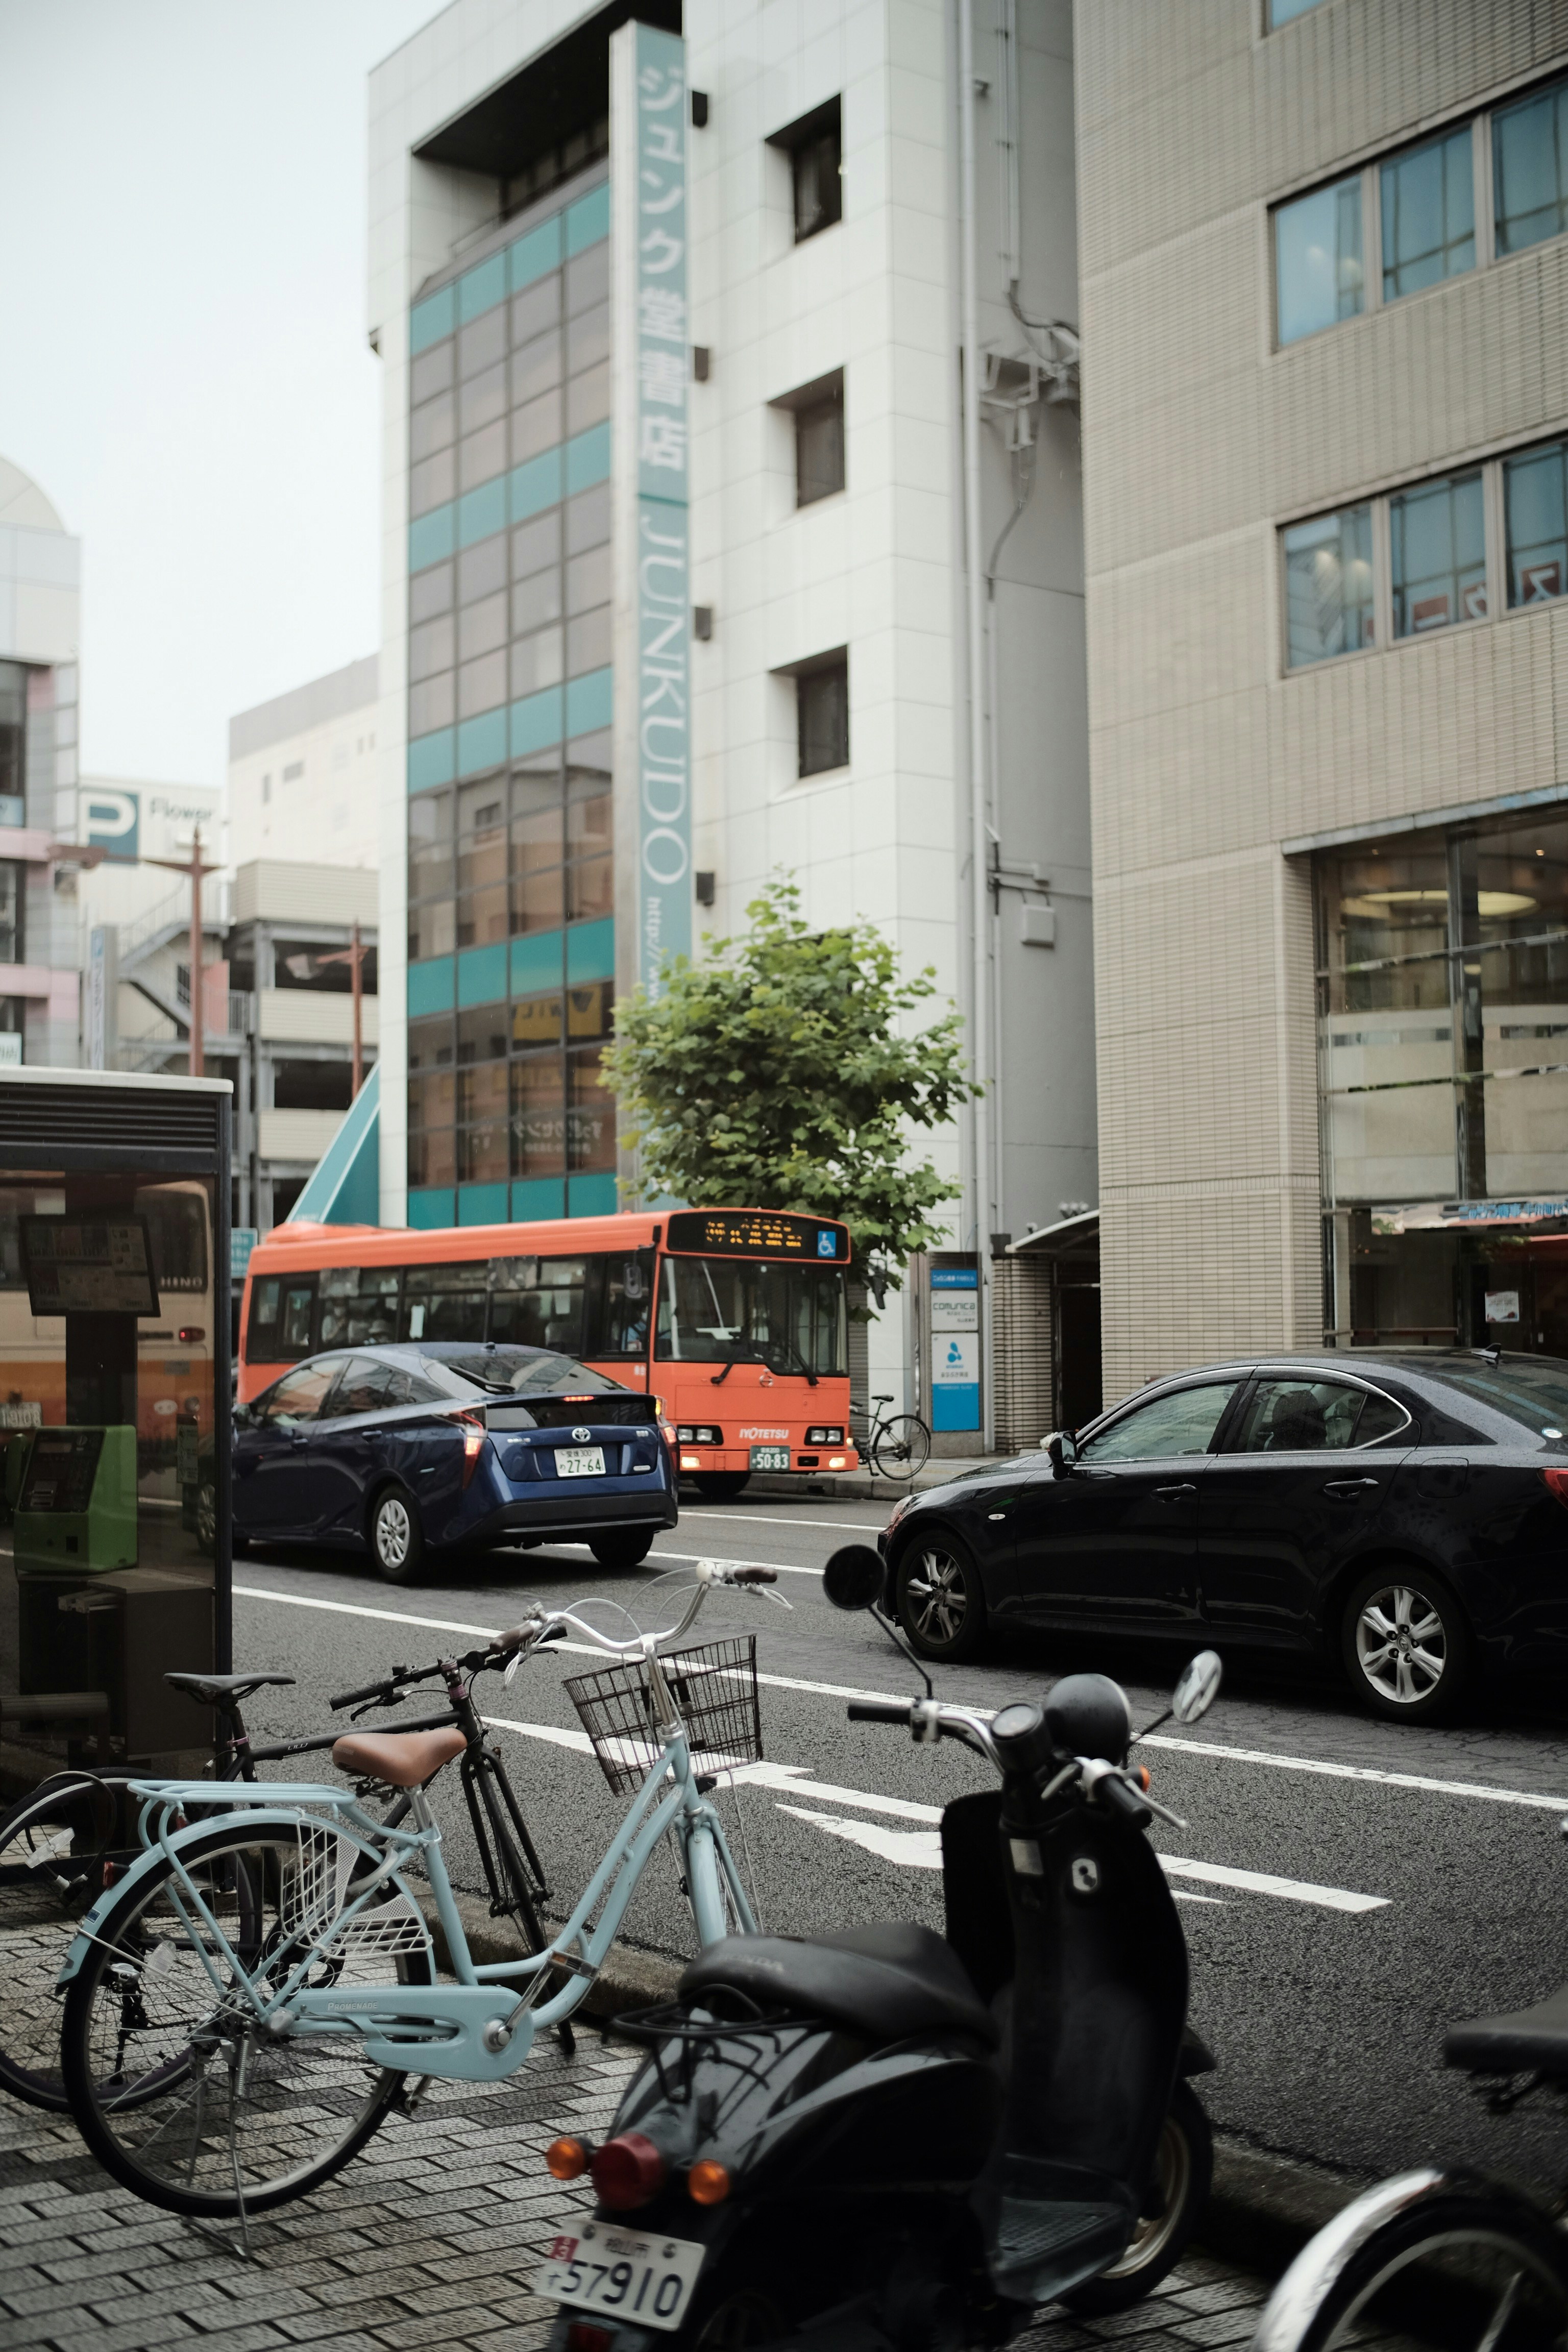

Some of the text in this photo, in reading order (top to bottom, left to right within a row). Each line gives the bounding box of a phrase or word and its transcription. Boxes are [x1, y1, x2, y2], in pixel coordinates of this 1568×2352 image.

[639, 64, 686, 470] ジュンク堂書店
[640, 513, 689, 885] JUNKUDO
[160, 1276, 203, 1288] HINO
[739, 1427, 790, 1439] IYOTETSU
[567, 1458, 601, 1474] 27-64
[756, 1453, 789, 1469] 50-83
[327, 2000, 378, 2012] PROMENADE
[604, 2237, 651, 2259] 松山市
[560, 2259, 683, 2317] 57910
